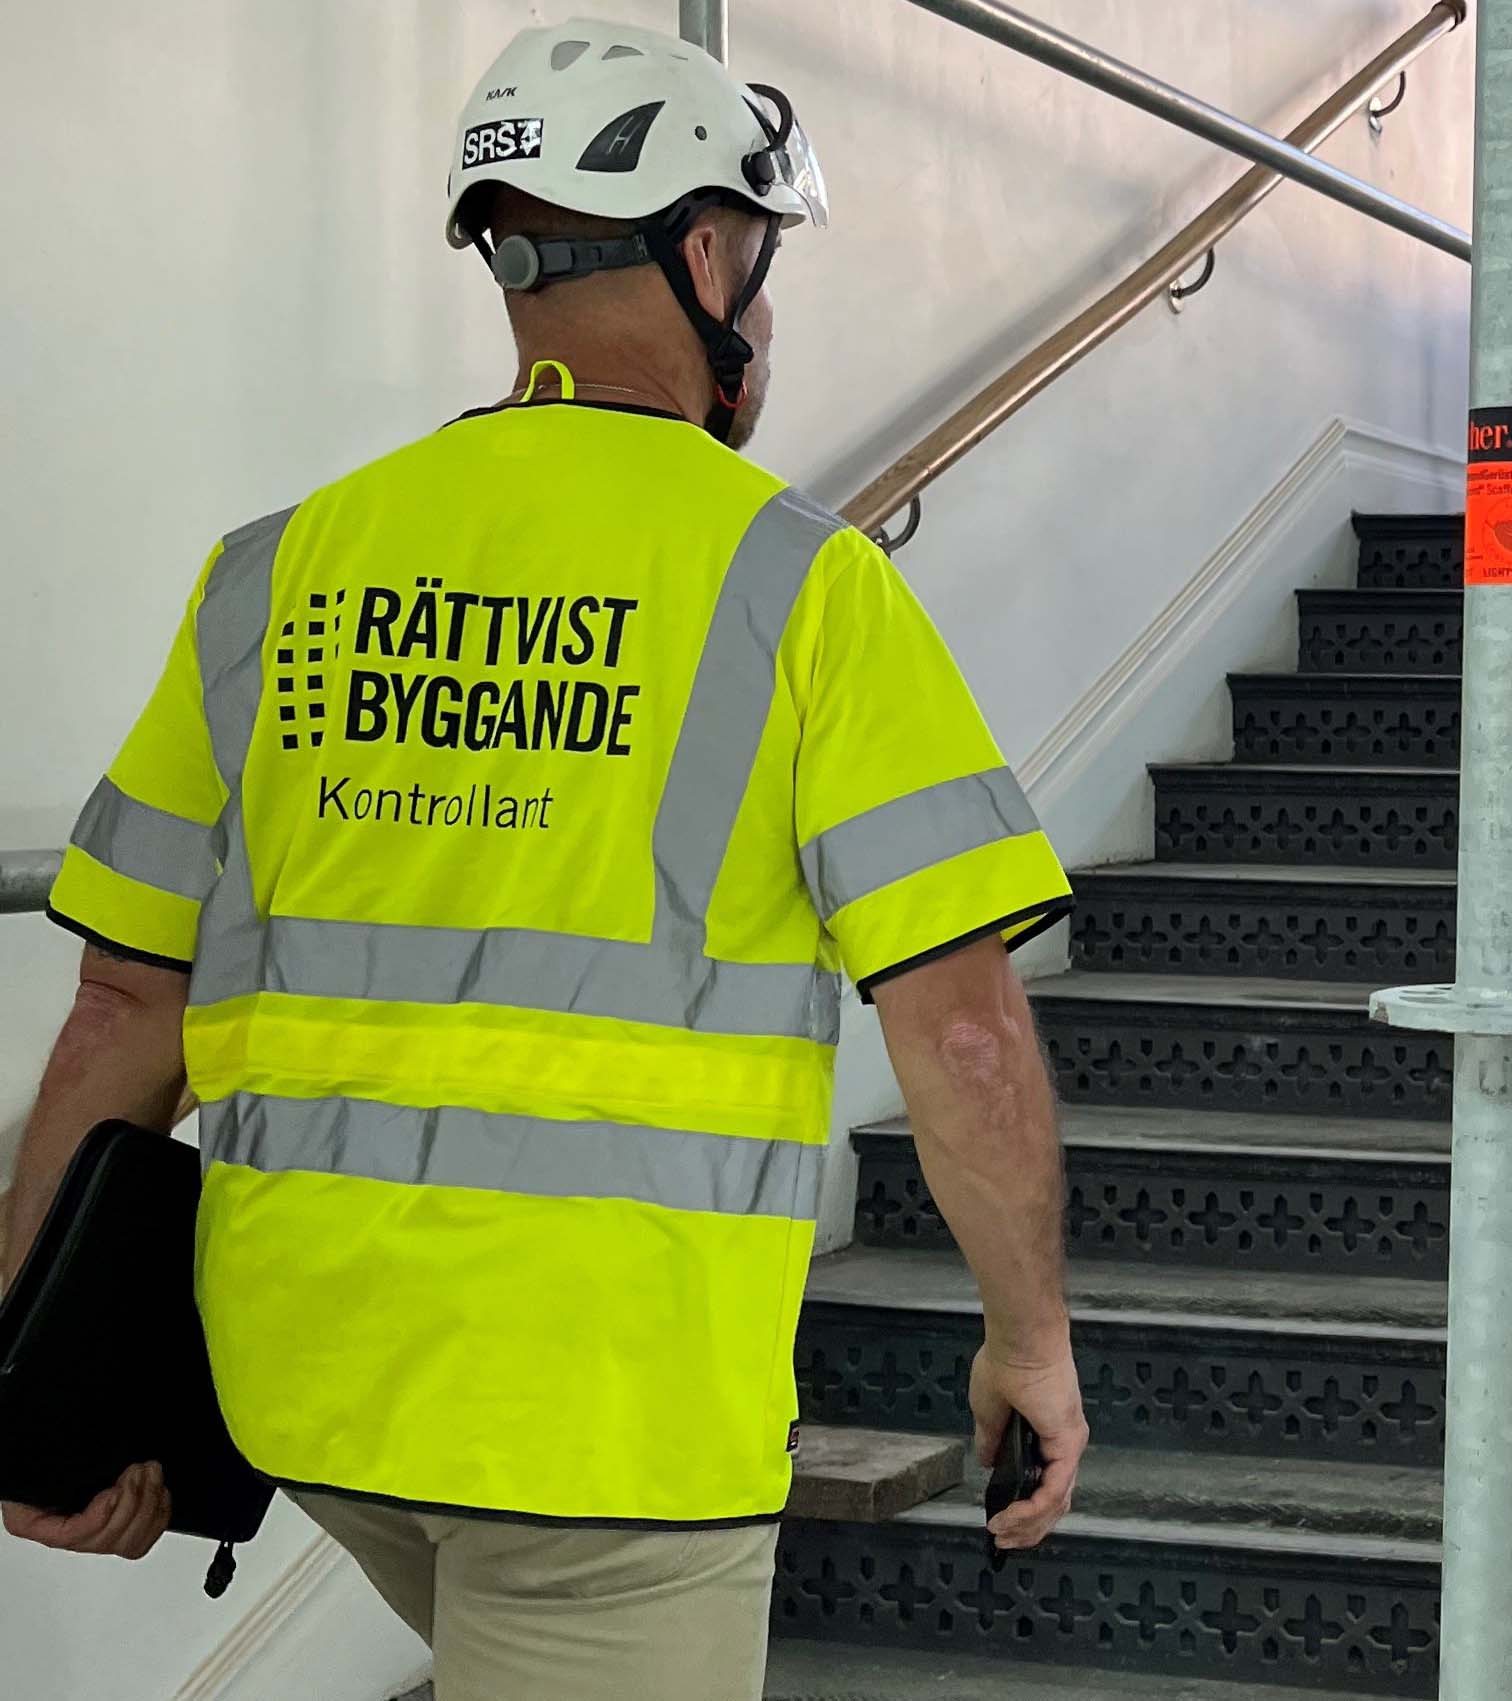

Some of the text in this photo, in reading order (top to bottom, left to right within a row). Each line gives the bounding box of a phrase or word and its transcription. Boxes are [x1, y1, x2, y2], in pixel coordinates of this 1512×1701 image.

[354, 577, 638, 667] RÄTTVIST
[344, 670, 641, 756] BYGGANDE
[318, 776, 552, 829] Kontrollant
